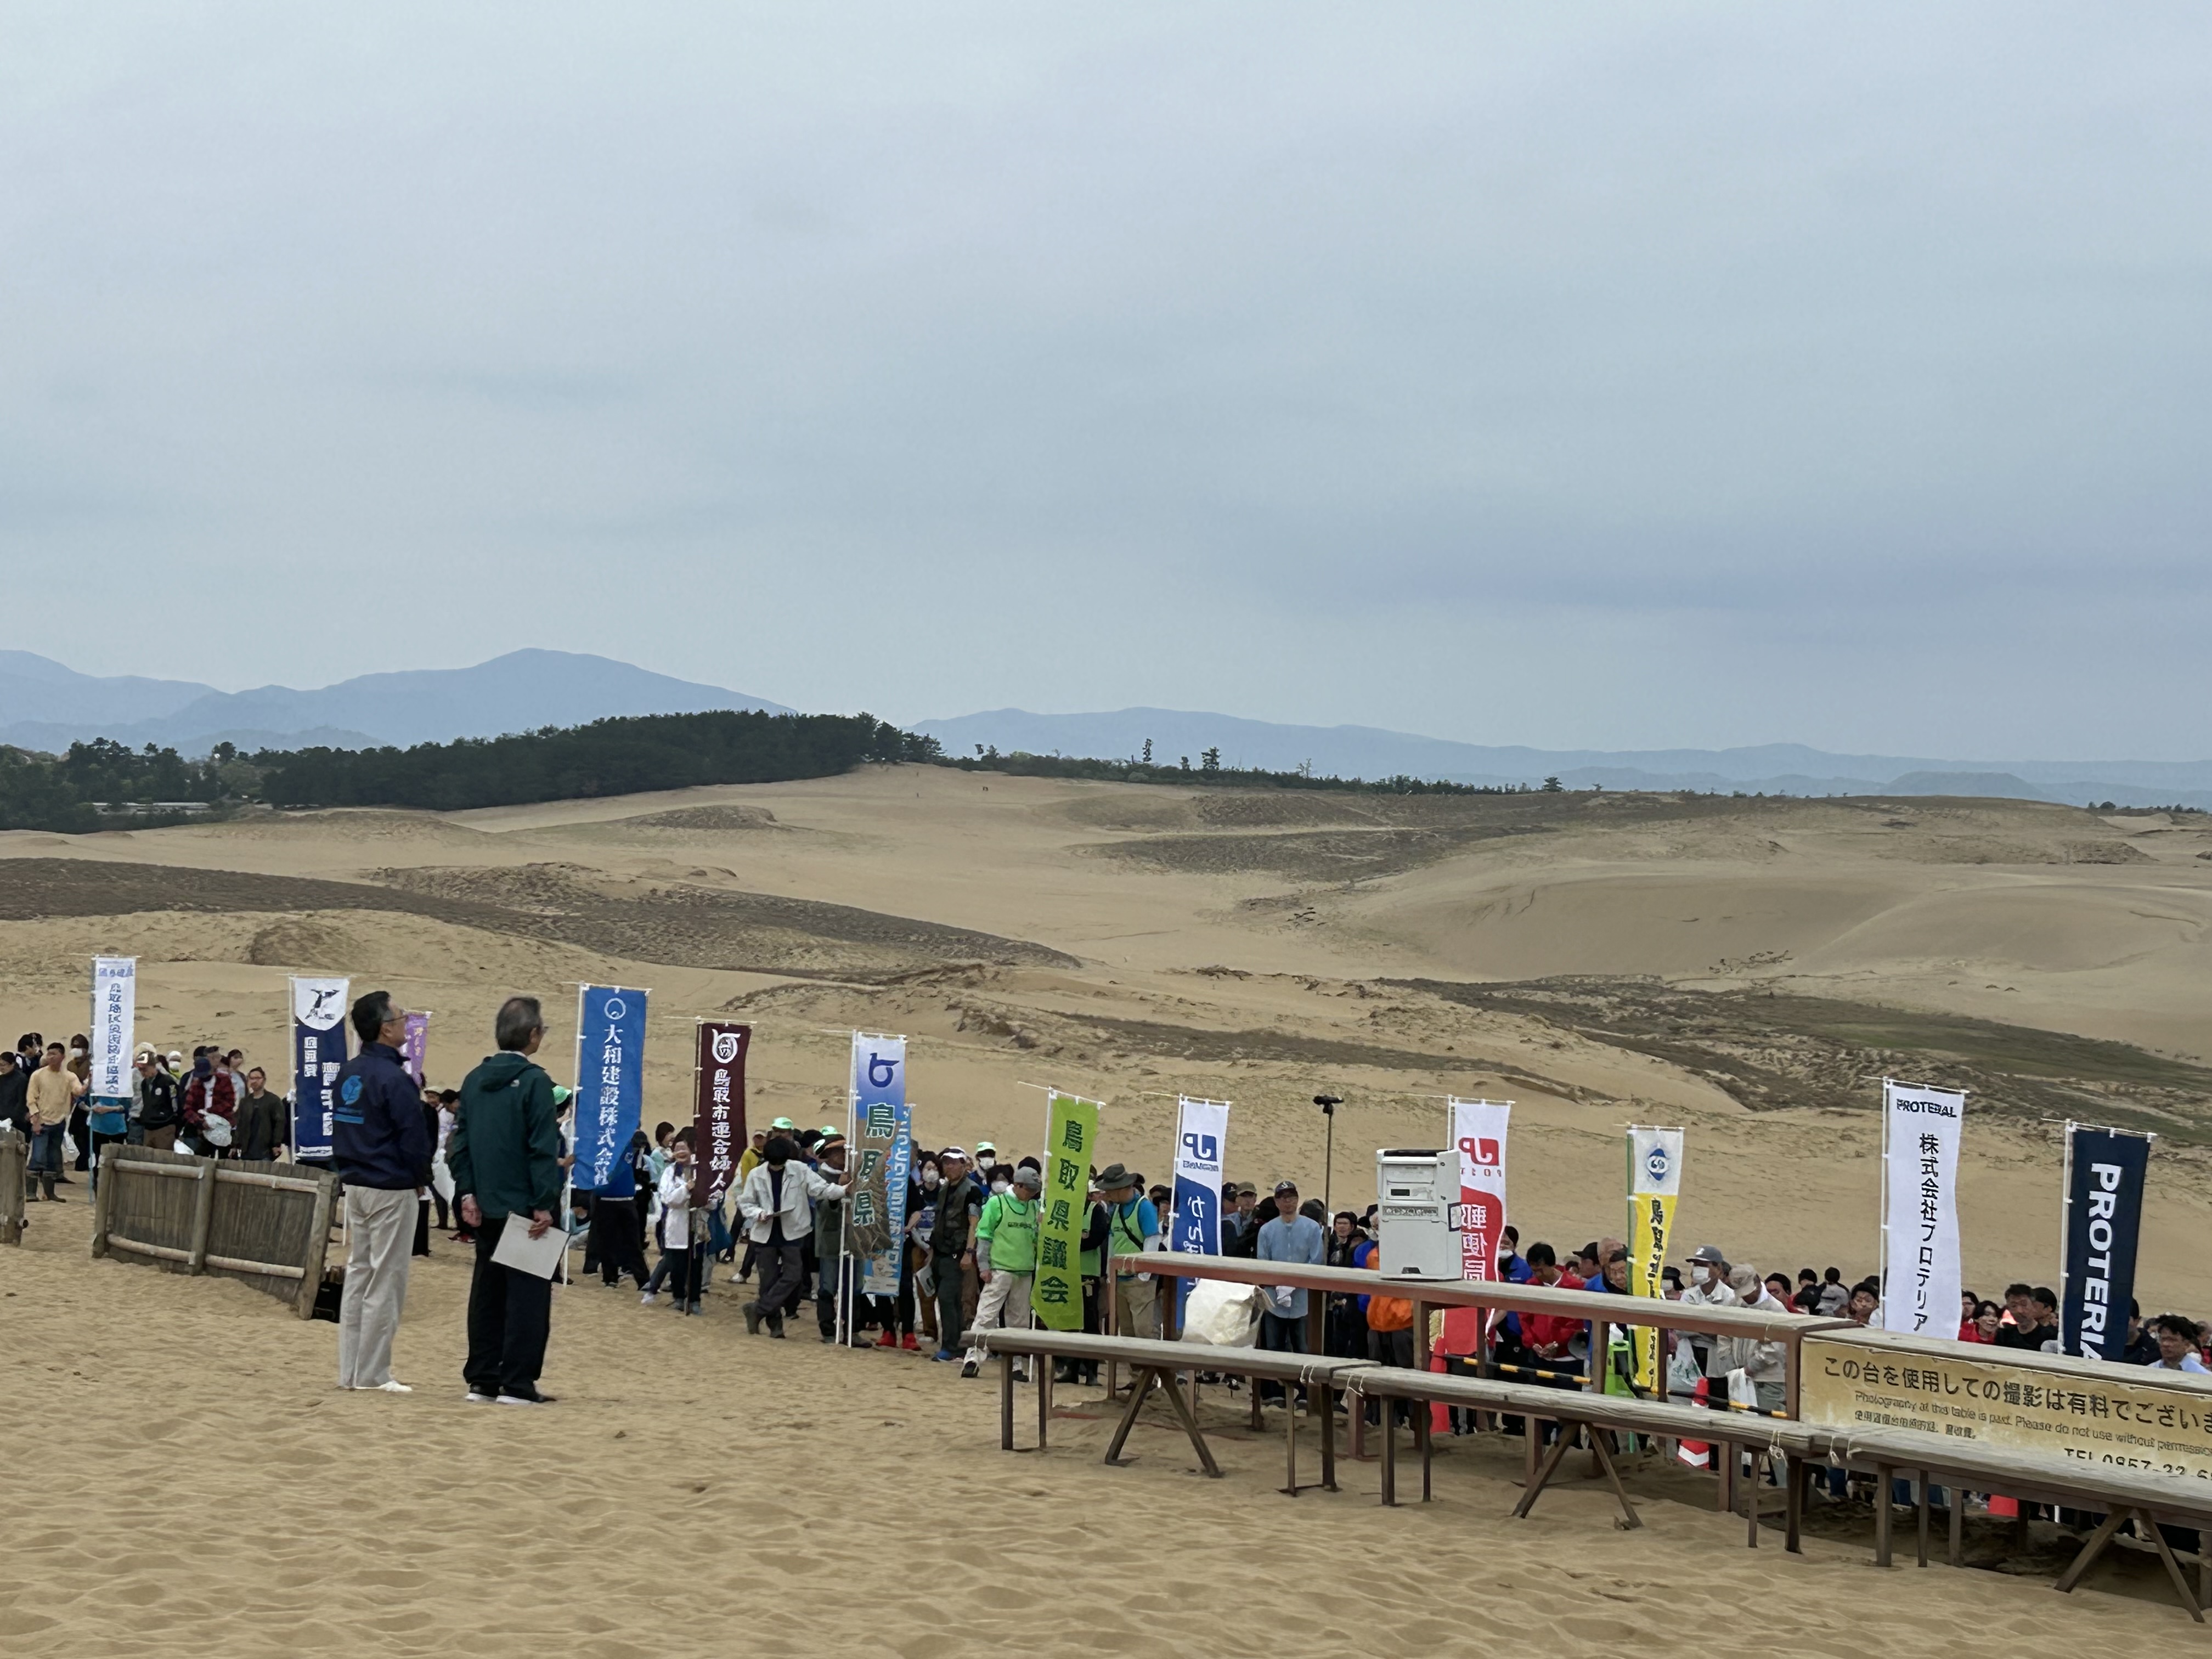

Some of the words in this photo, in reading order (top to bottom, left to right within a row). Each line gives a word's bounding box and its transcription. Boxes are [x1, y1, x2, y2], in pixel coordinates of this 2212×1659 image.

[594, 1024, 624, 1186] 大和建設株式会社
[708, 1068, 732, 1204] 鳥取市連合婦人会
[1040, 1119, 1083, 1304] 鳥取県議会
[1913, 1132, 1939, 1331] 株式会社プロテリア
[2092, 1430, 2113, 1441] use
